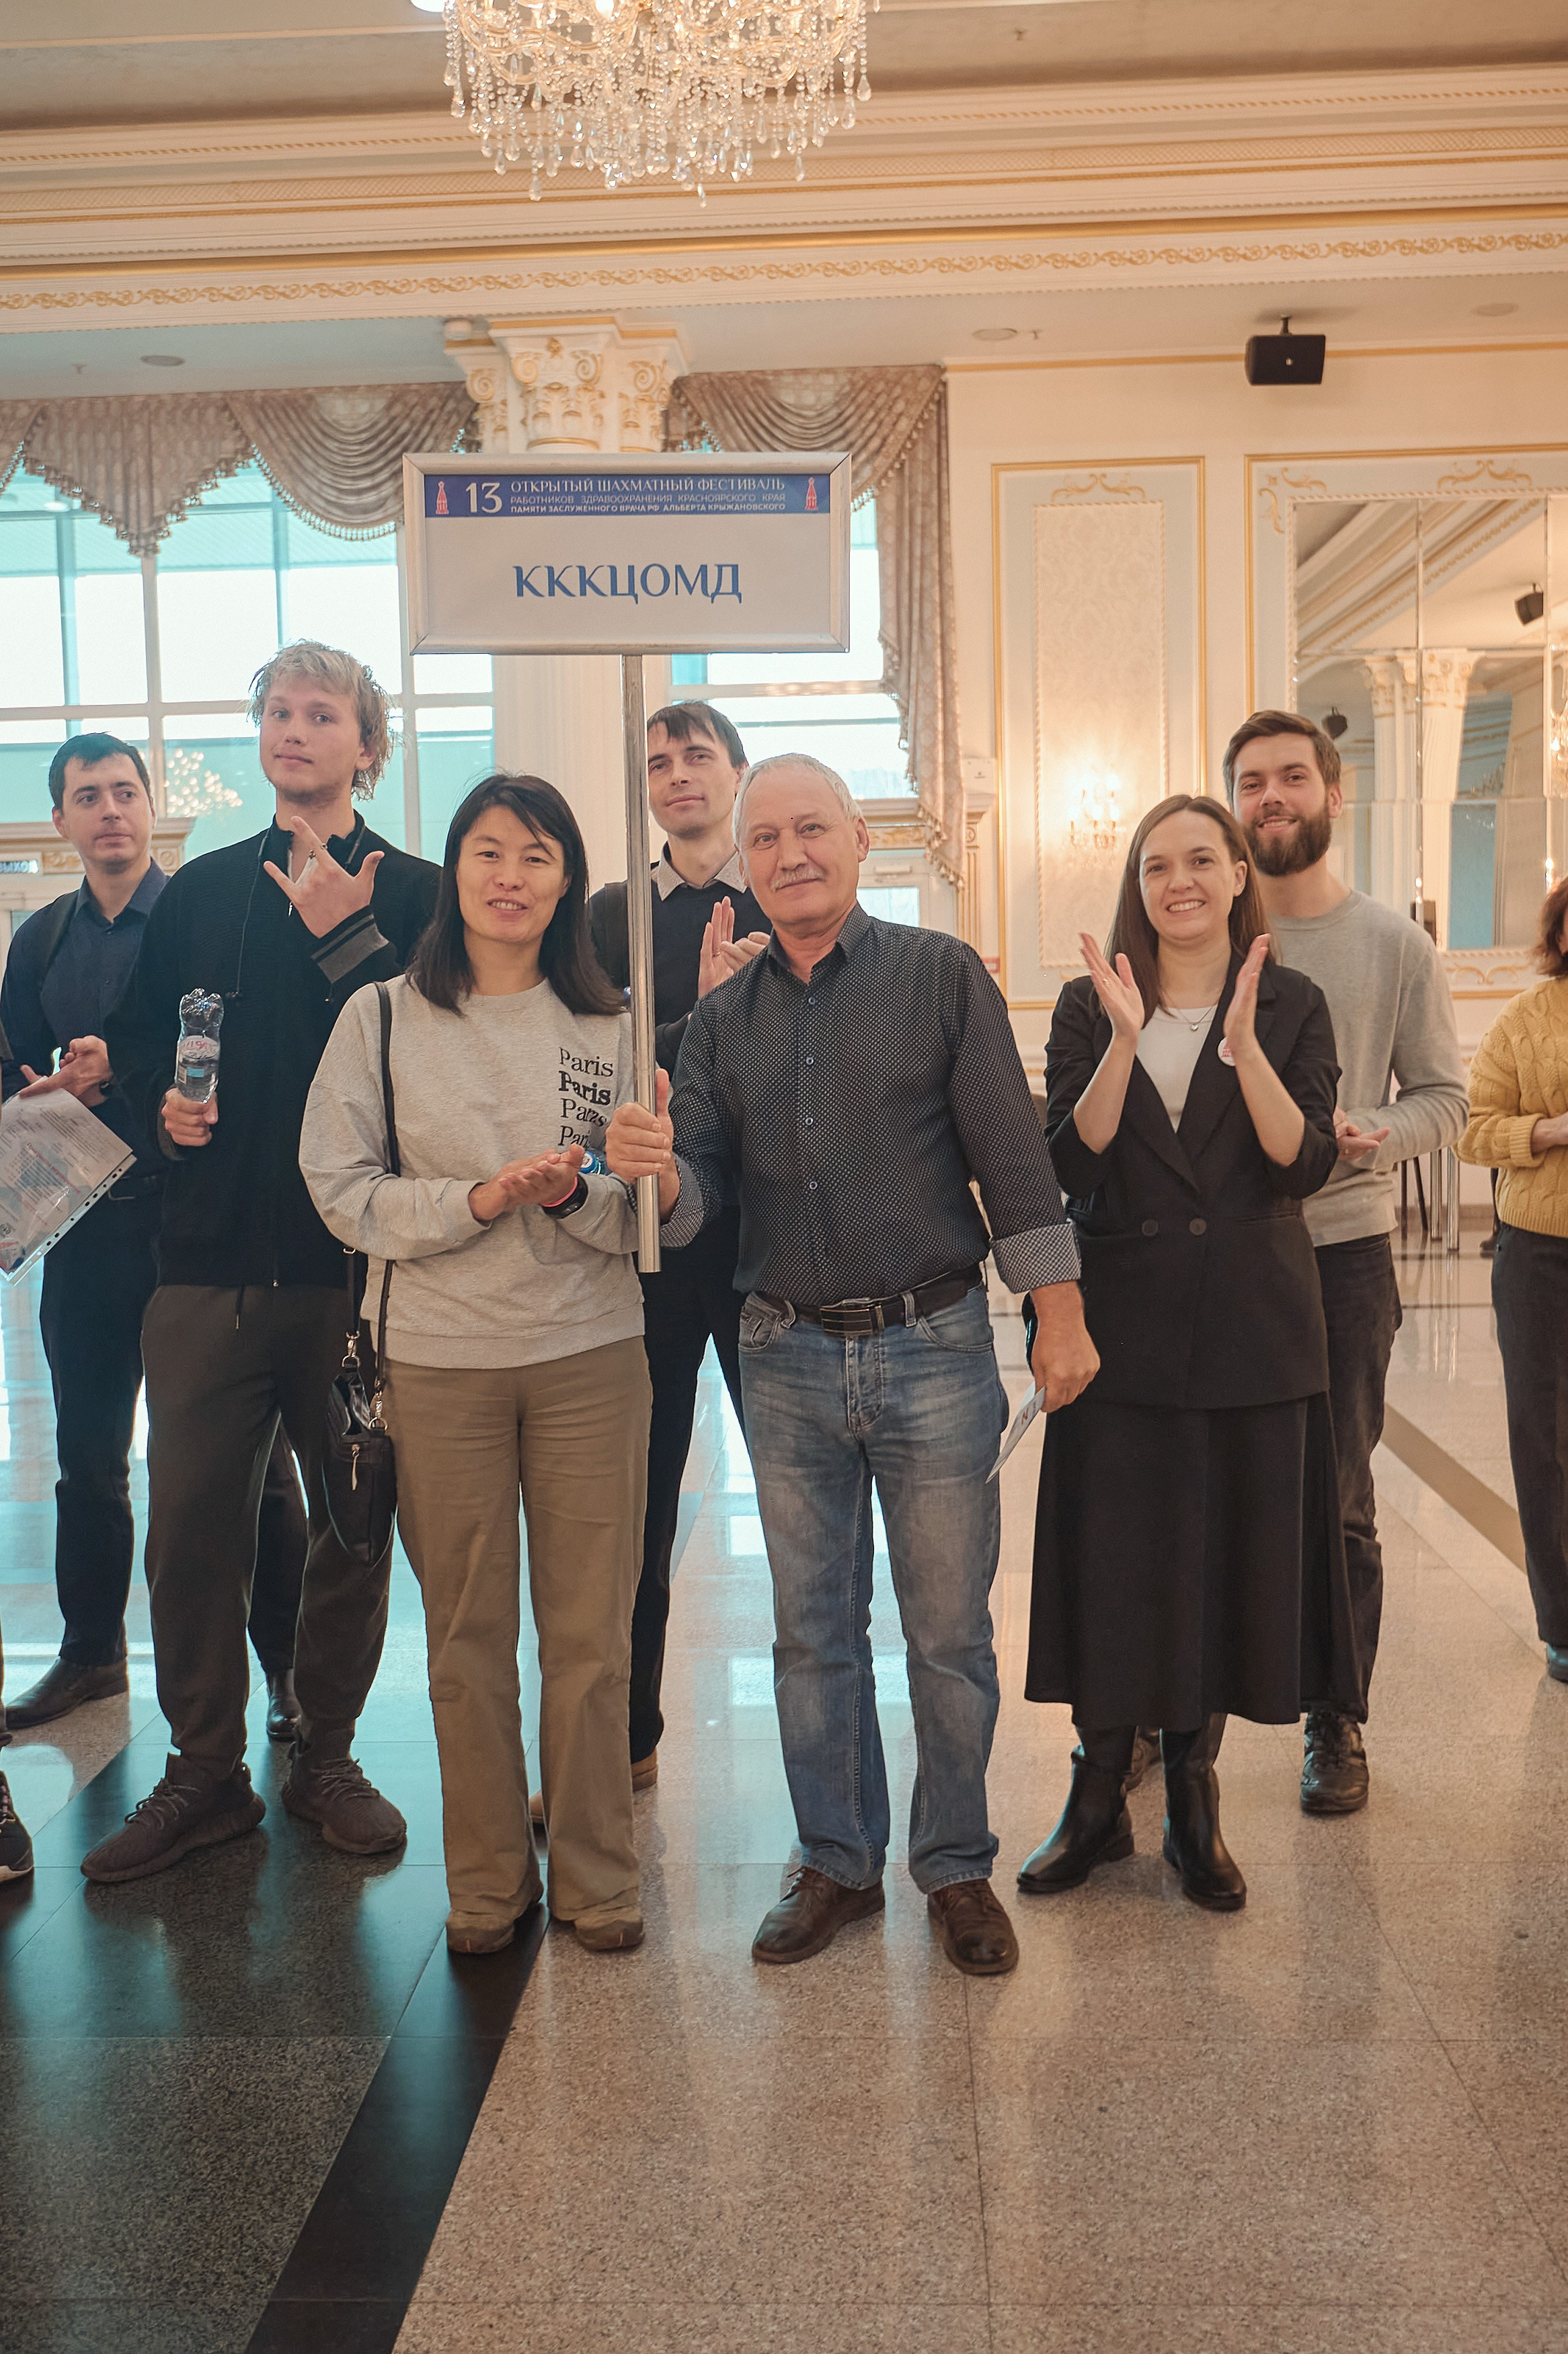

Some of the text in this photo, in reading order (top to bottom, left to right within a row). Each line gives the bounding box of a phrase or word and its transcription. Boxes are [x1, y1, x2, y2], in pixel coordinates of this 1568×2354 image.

[465, 482, 503, 513] 13
[510, 477, 785, 493] ОТКРЫТЫЙ ШАХМАТНЫЙ ФЕСТИВАЛЬ
[510, 493, 786, 504] РАБОТНИКОВ ЗДРАВООХРАНЕНИЯ КРАСНОЯРСКОГО КРАЯ
[664, 504, 706, 512] АЛЬБЕРТА
[708, 503, 786, 511] КРЫЖАНОВСКОГО
[512, 563, 742, 605] КККЦОМД
[559, 1047, 614, 1077] Paris
[558, 1070, 612, 1106] Paris
